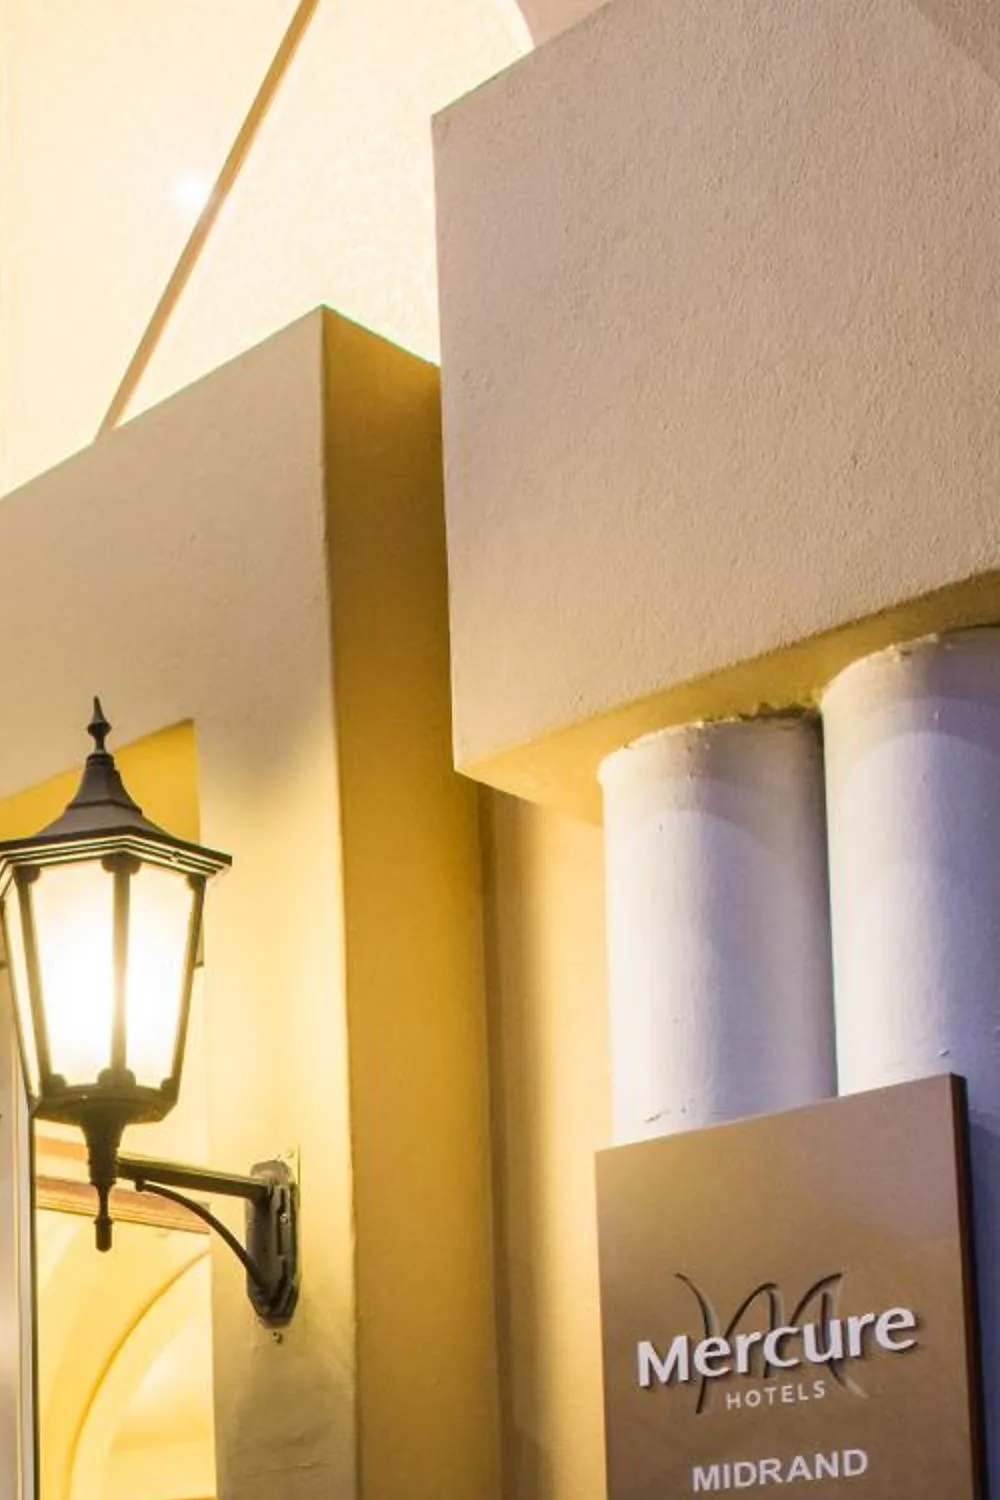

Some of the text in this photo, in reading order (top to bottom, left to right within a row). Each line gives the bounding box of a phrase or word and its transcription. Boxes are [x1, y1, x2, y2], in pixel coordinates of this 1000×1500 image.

[637, 1305, 918, 1387] Mercure
[726, 1380, 826, 1410] HOTELS
[692, 1449, 868, 1493] MIDRAND
